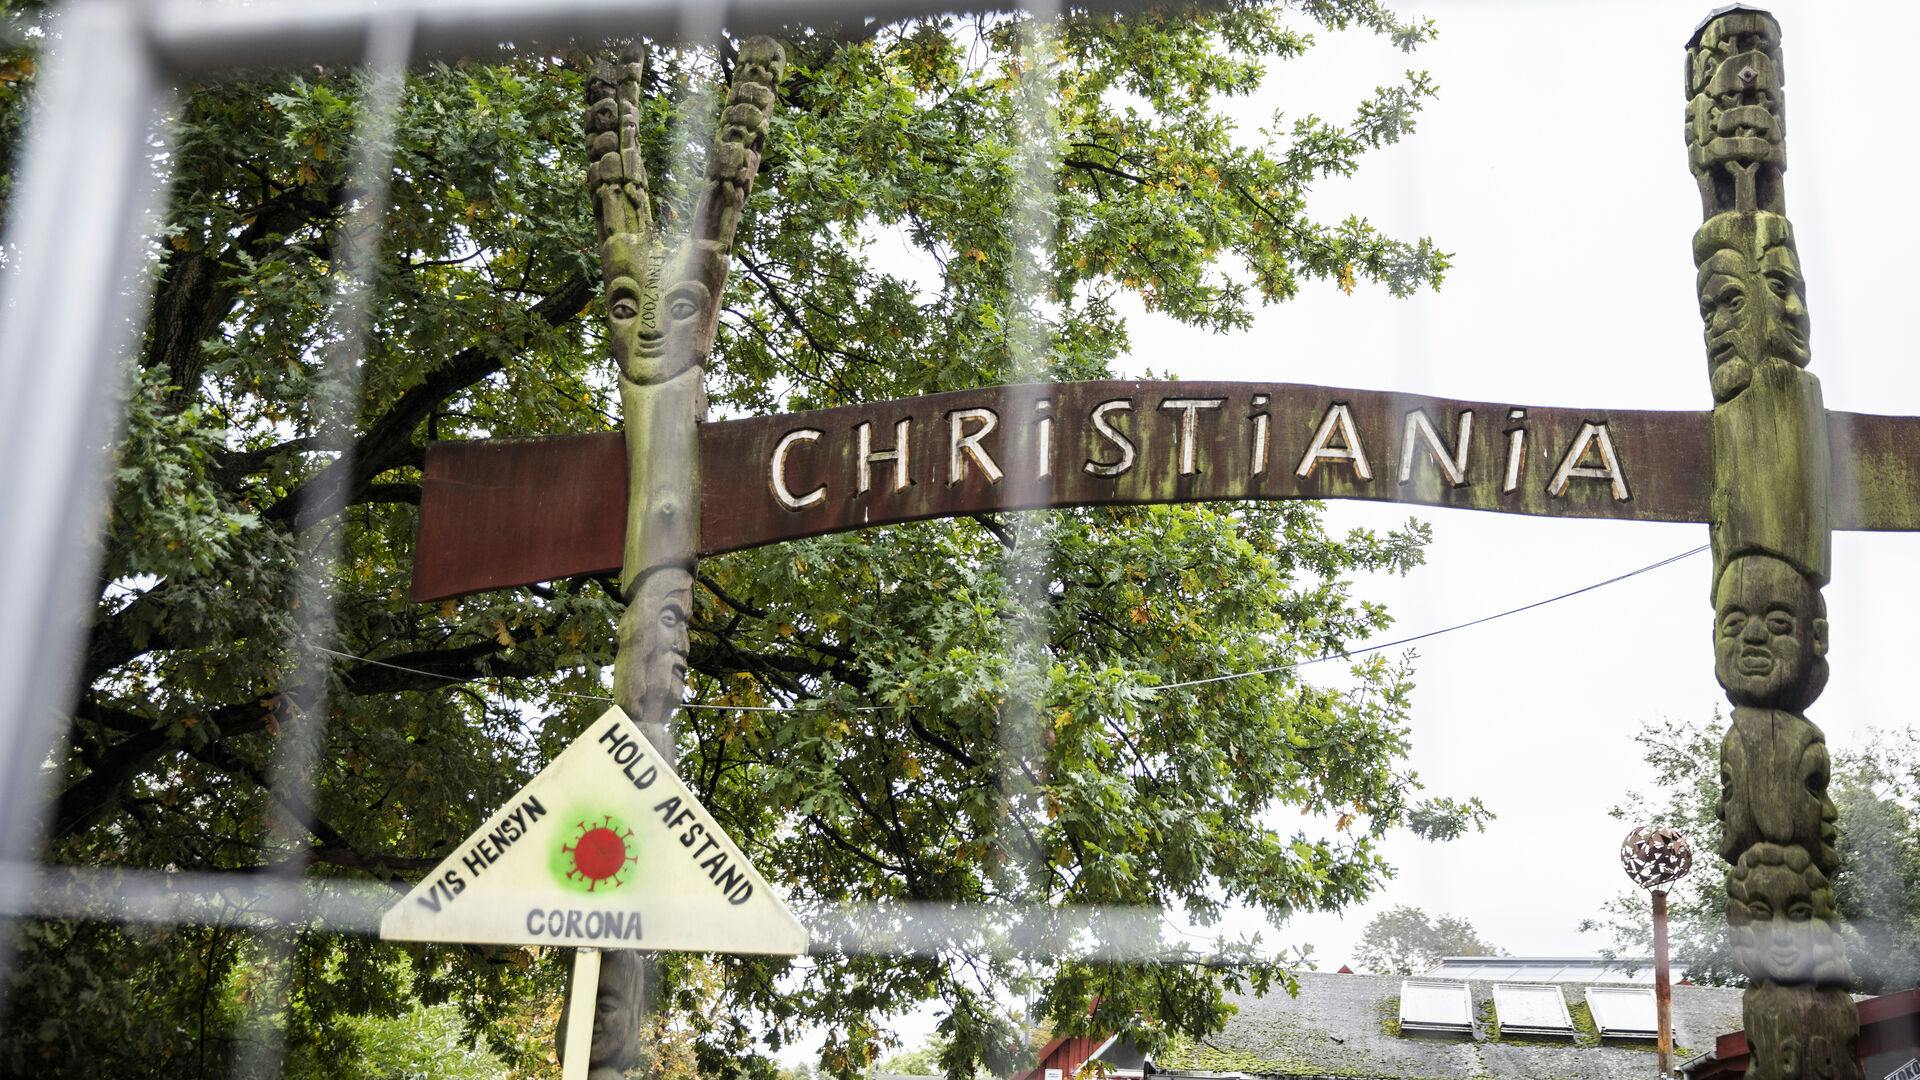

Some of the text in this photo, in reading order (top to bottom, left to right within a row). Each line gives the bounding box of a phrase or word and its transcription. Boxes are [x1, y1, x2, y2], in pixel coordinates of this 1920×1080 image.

[642, 293, 660, 329] 2002
[598, 722, 754, 905] HOLD AFSTAND
[417, 795, 547, 913] VIS HENSYN
[526, 908, 643, 940] CORONA
